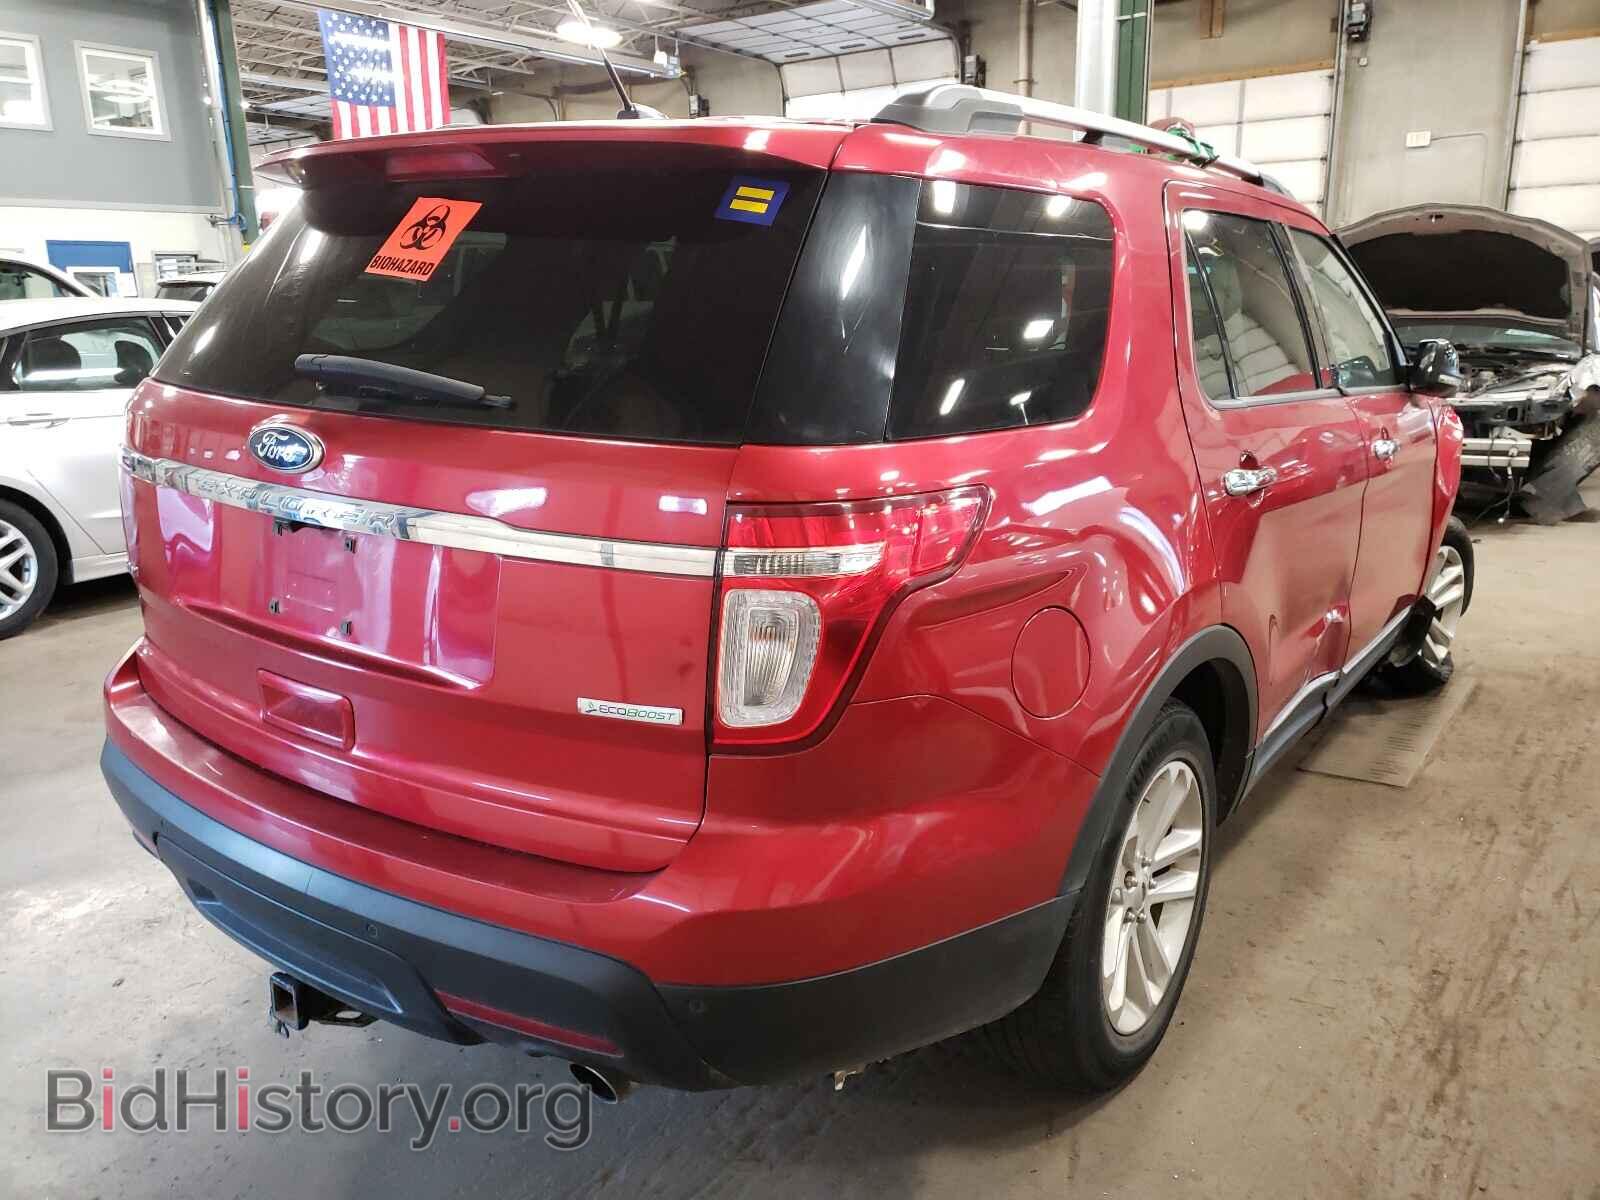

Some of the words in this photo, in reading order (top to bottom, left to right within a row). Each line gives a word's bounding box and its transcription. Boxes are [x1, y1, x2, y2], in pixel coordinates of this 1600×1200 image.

[370, 255, 435, 276] BIOHAZARD
[257, 431, 309, 461] Ford
[598, 704, 676, 721] ECOBOOST
